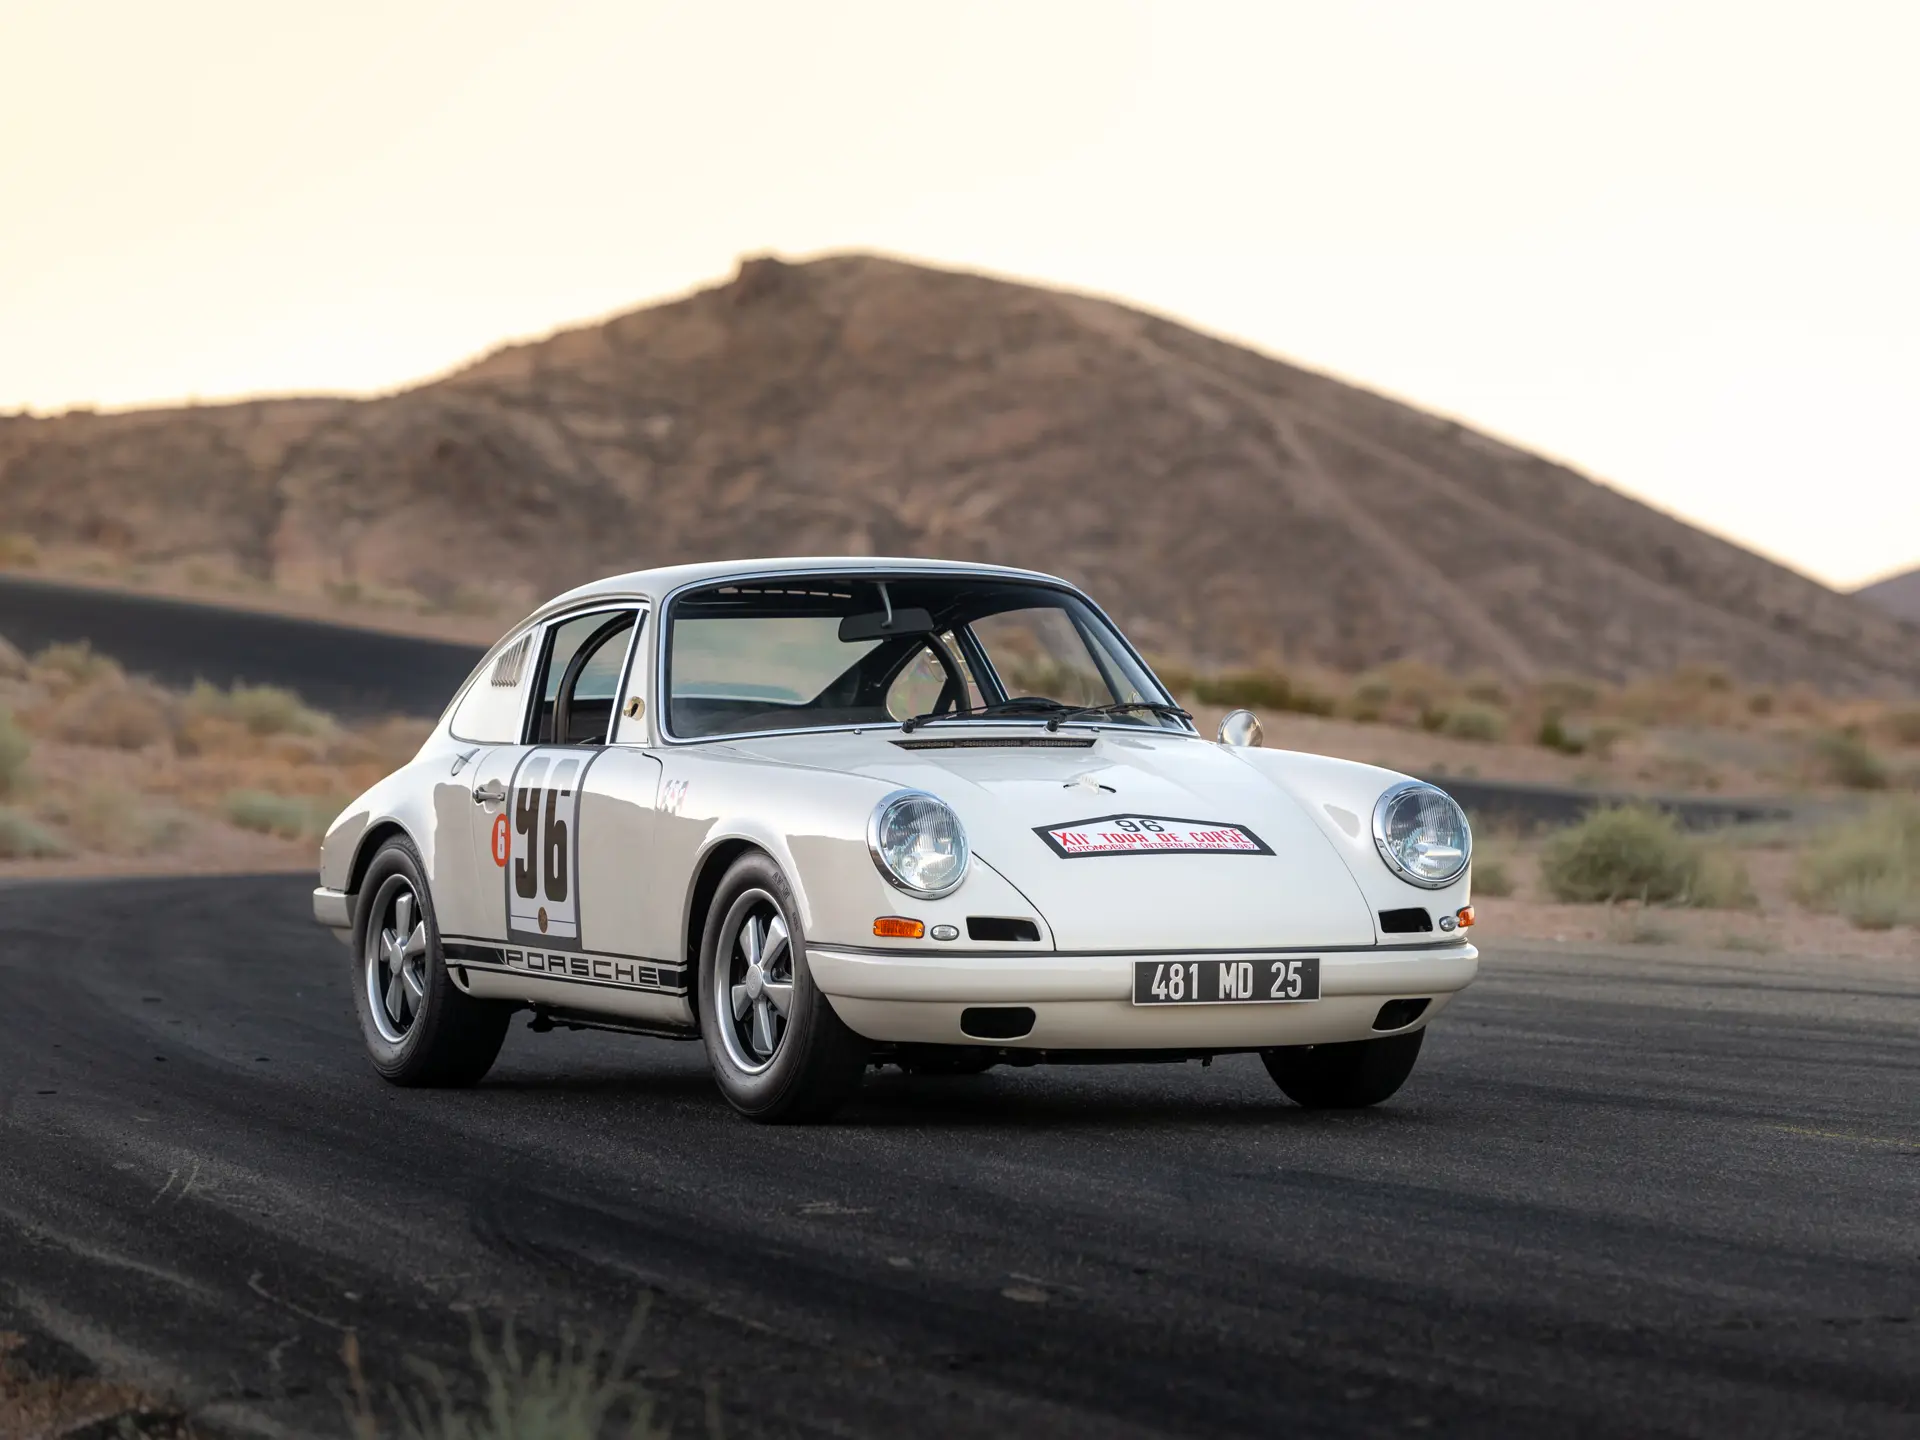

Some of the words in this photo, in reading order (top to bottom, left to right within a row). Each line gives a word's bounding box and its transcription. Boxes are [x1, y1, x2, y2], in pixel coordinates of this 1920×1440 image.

[515, 757, 579, 902] 96
[1097, 833, 1149, 844] TOUR
[1155, 833, 1183, 843] DE
[1189, 827, 1251, 844] CORSE
[1115, 819, 1164, 832] 96
[1067, 843, 1136, 853] AUTOMOBILE
[1140, 842, 1231, 850] INTERNATIONAL
[505, 949, 659, 985] PORSCHE
[1151, 963, 1199, 1000] 481
[1219, 962, 1253, 999] MD
[1270, 961, 1302, 998] 25
